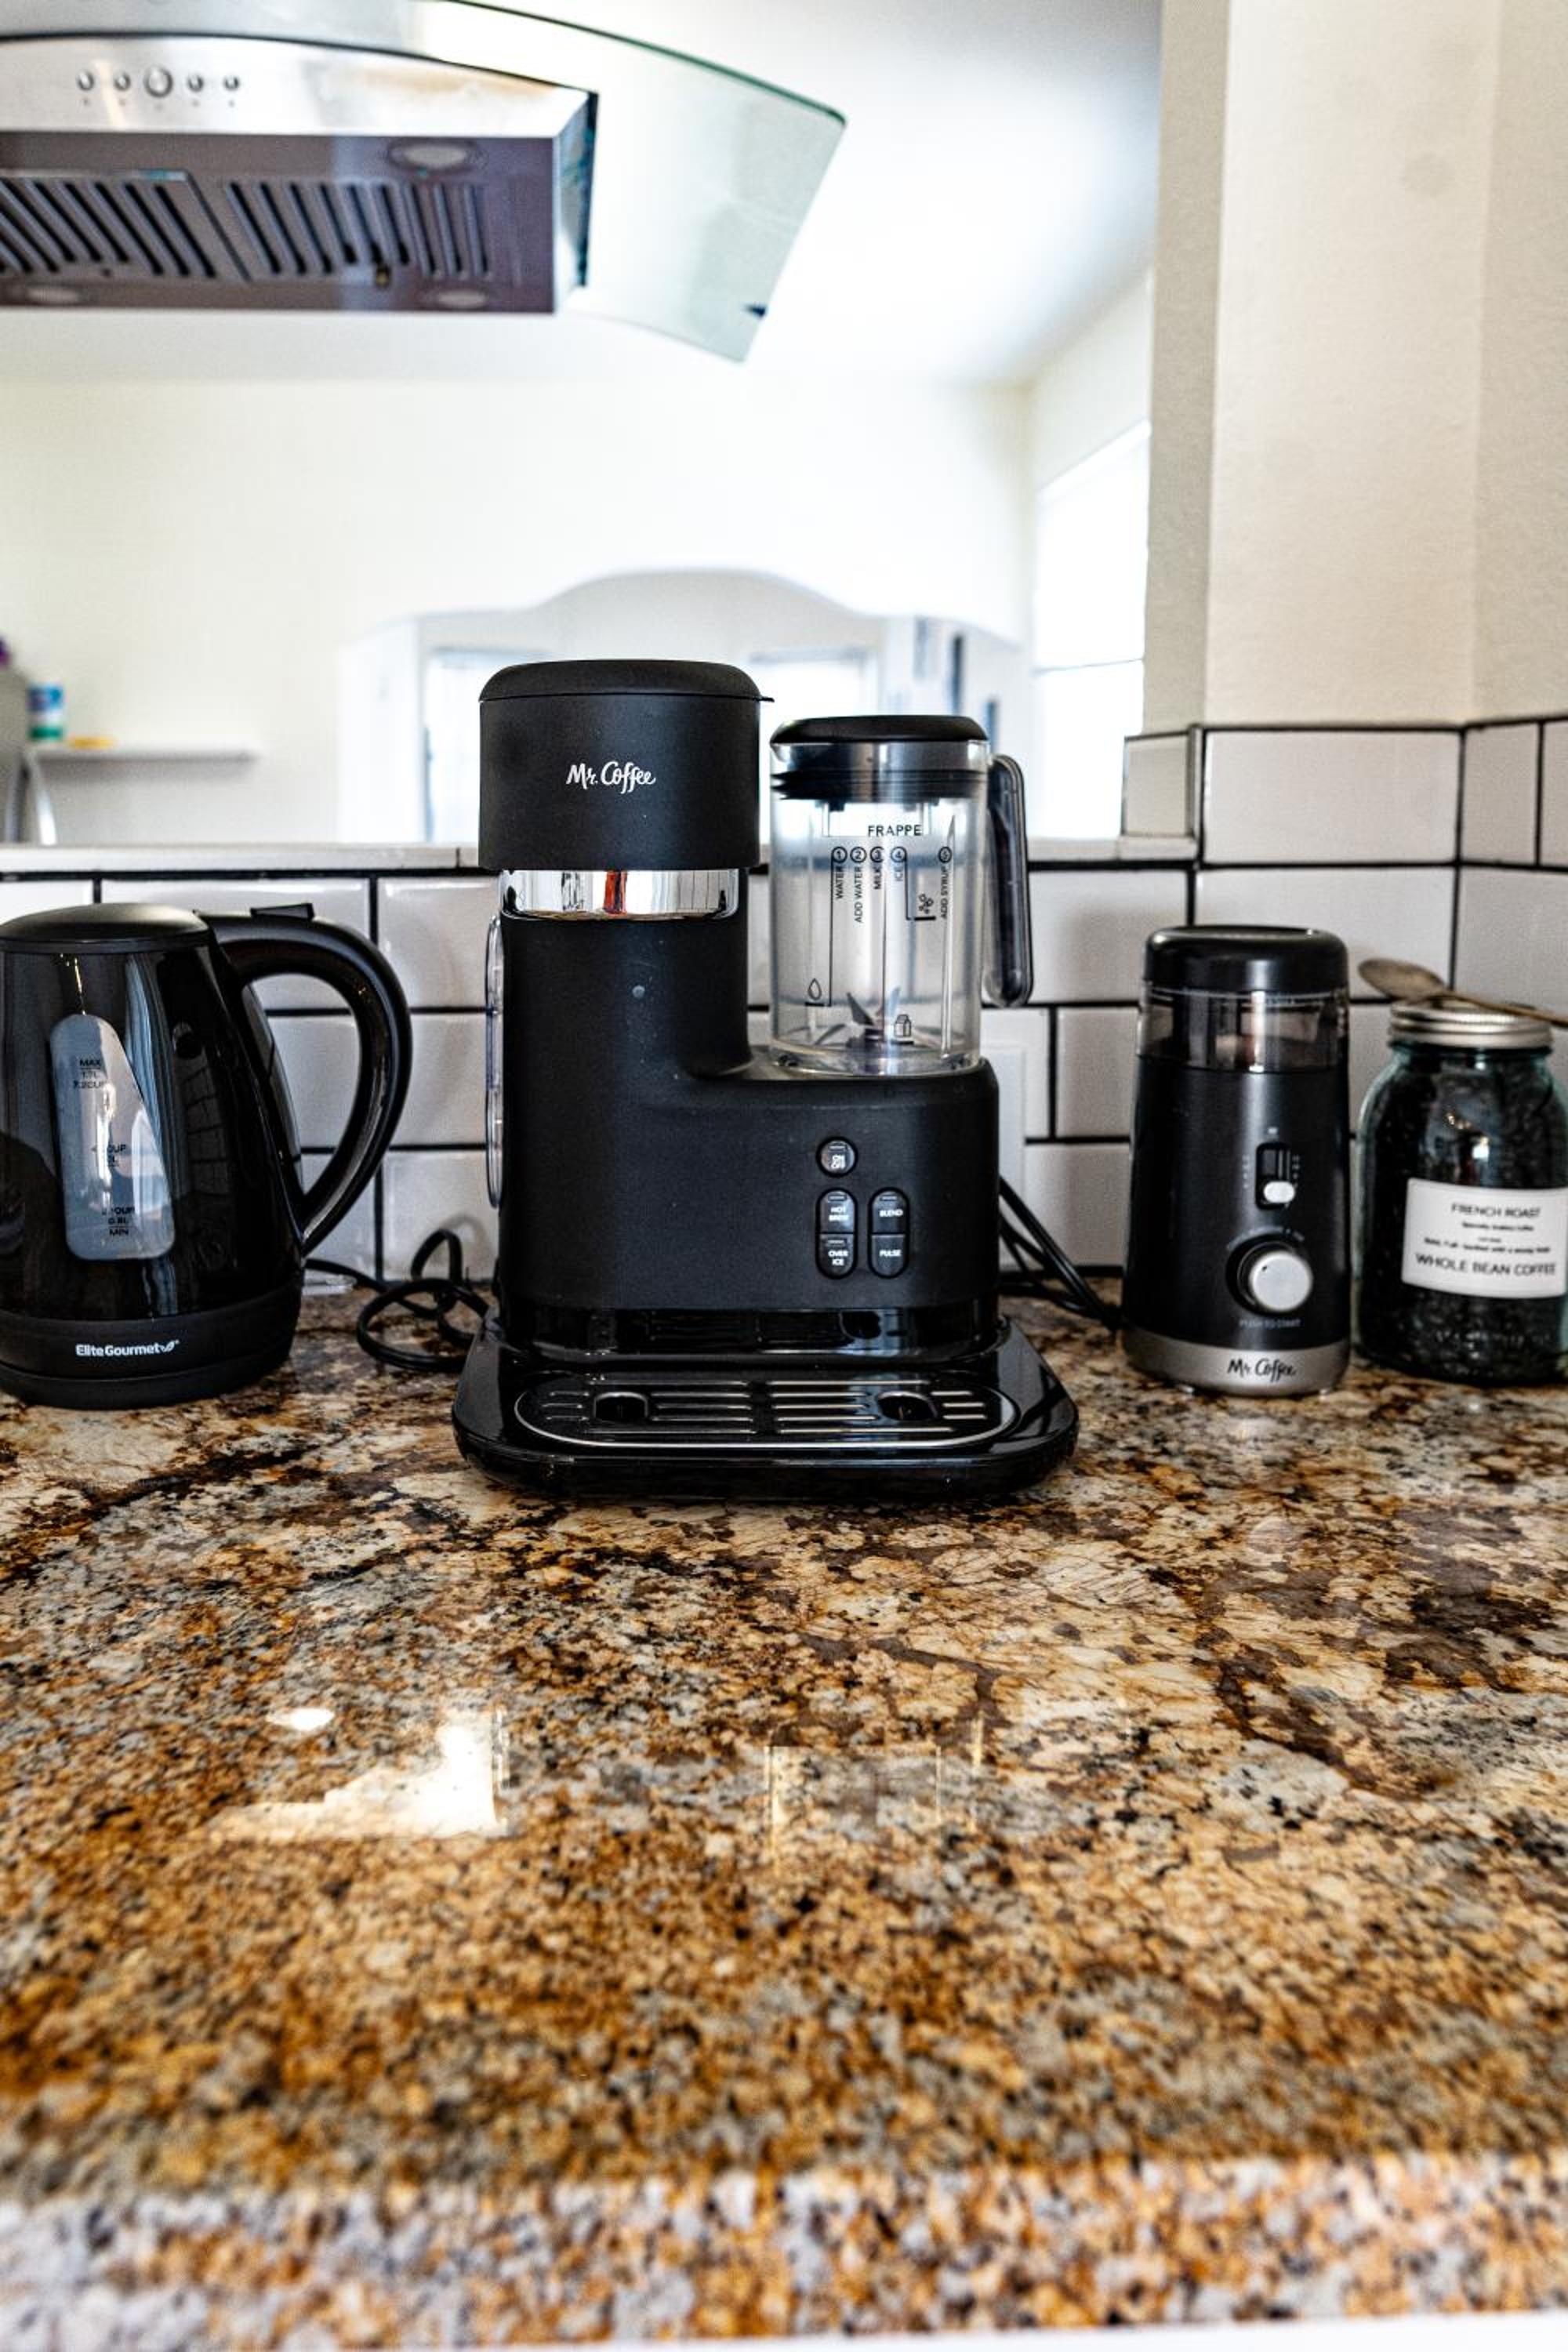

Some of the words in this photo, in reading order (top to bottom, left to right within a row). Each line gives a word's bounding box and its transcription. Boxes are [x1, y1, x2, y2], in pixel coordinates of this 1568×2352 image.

[565, 763, 598, 789] Mr.
[601, 760, 656, 794] Coffee
[868, 825, 921, 837] FRAPPE
[835, 866, 844, 900] WATER
[854, 866, 863, 900] WATER
[873, 866, 882, 890] MILK
[854, 901, 863, 923] ADD
[80, 1058, 102, 1067] MAX
[1452, 1203, 1501, 1217] FRENCH
[1504, 1207, 1541, 1218] ROAST
[879, 1249, 902, 1258] PULSE
[1415, 1253, 1468, 1272] WHOLE
[1472, 1261, 1512, 1276] BEAN
[1513, 1263, 1556, 1277] COFFEE
[1254, 1358, 1297, 1382] Coffee
